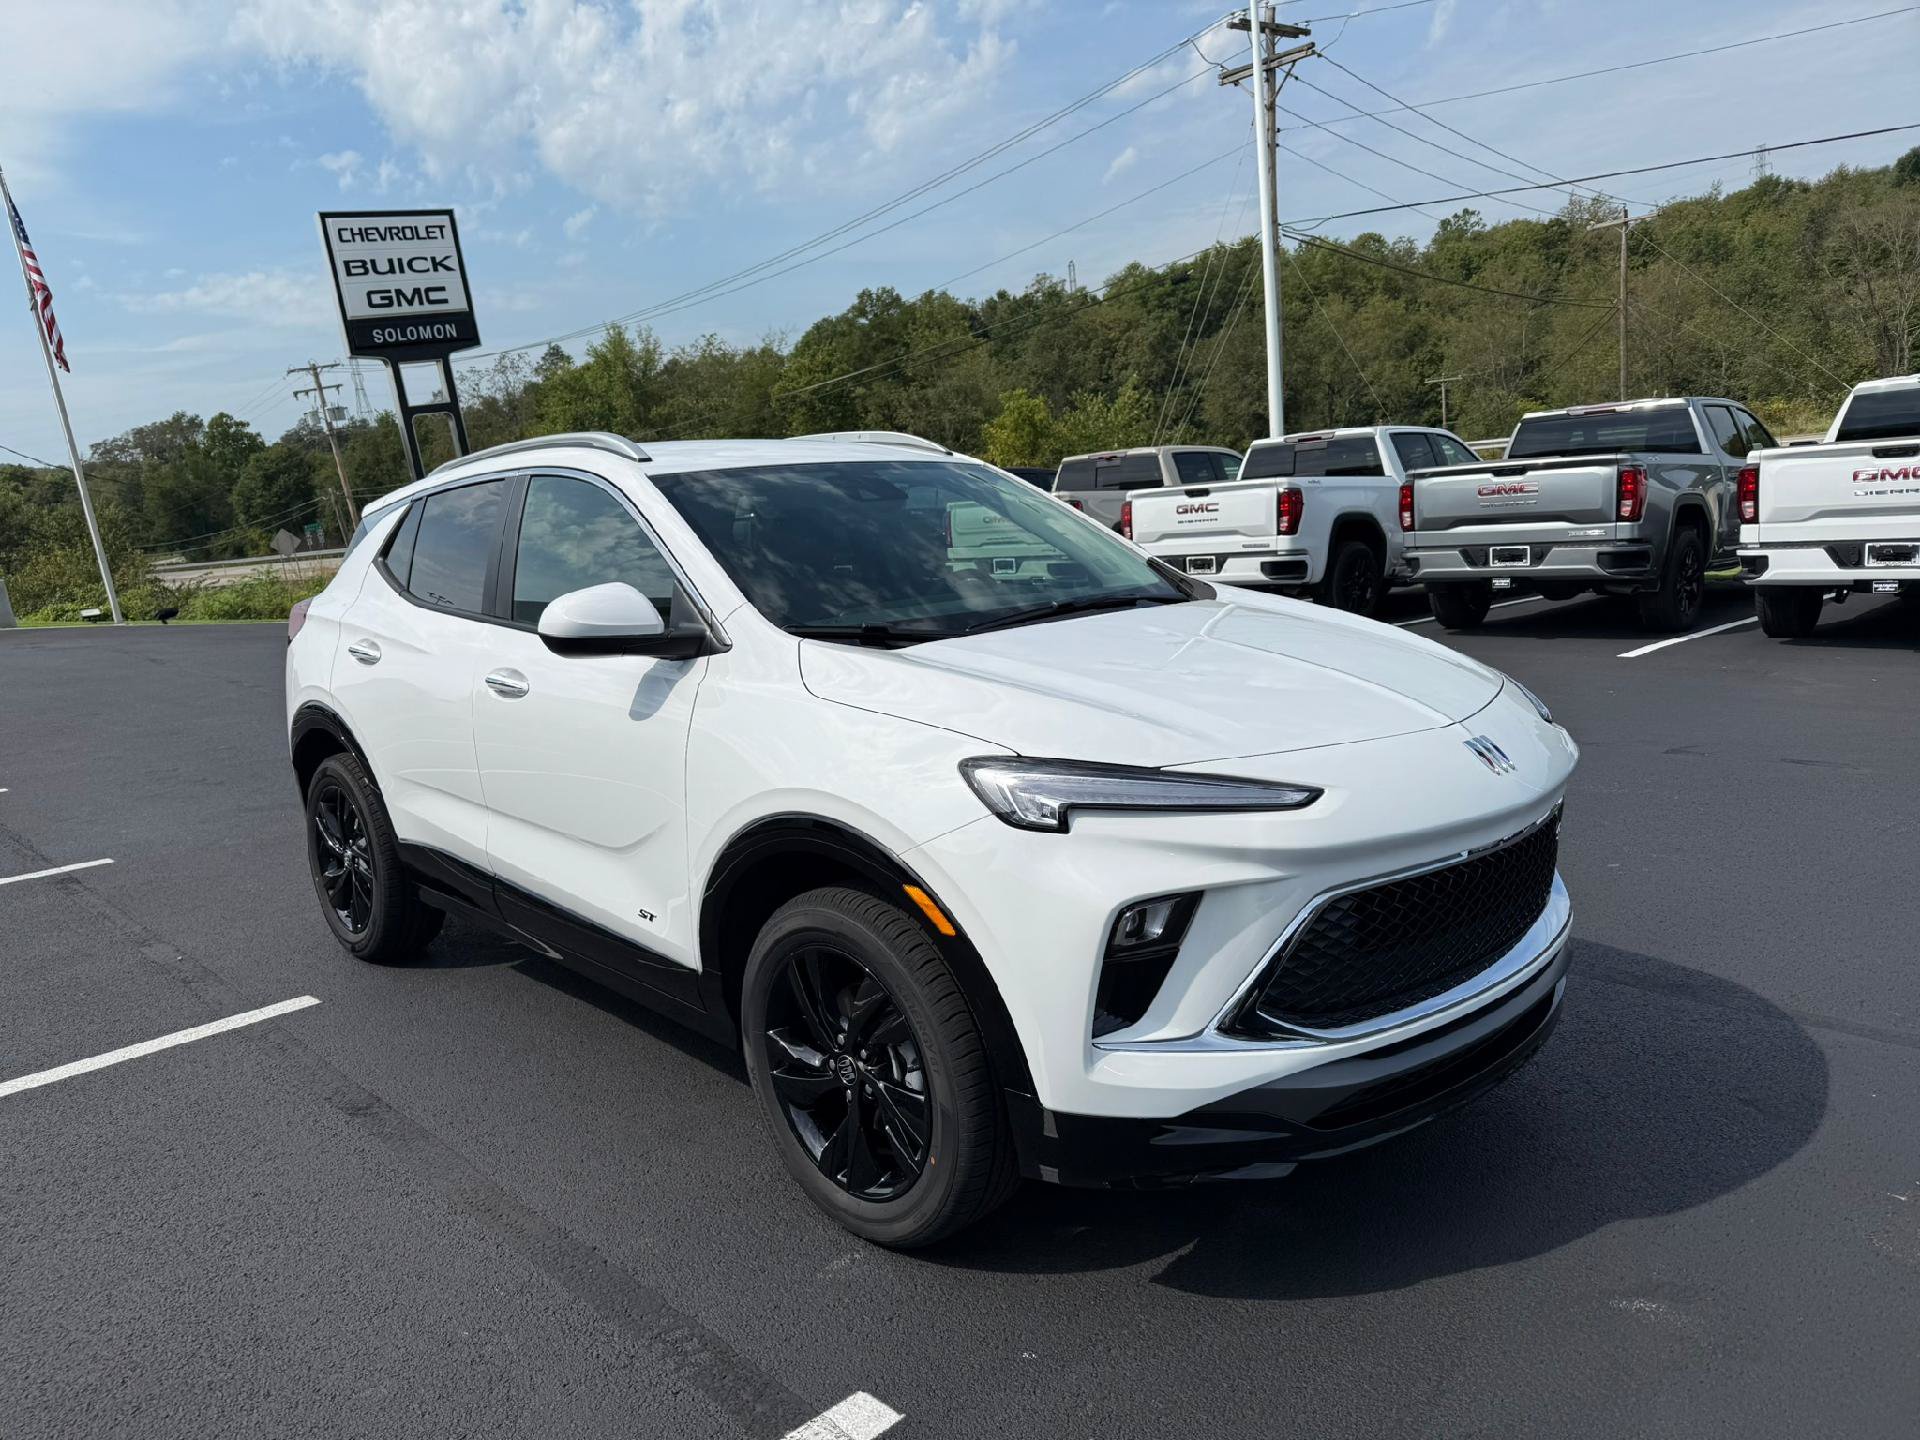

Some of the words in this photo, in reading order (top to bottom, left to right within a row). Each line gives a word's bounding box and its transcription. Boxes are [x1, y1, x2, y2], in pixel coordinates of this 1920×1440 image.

[337, 225, 446, 243] CHEVROLET
[342, 255, 456, 277] BUICK
[366, 286, 449, 308] GMC
[372, 324, 457, 343] SOLOMON
[1477, 482, 1539, 498] GMC
[1176, 503, 1219, 514] GMC
[637, 909, 657, 922] ST
